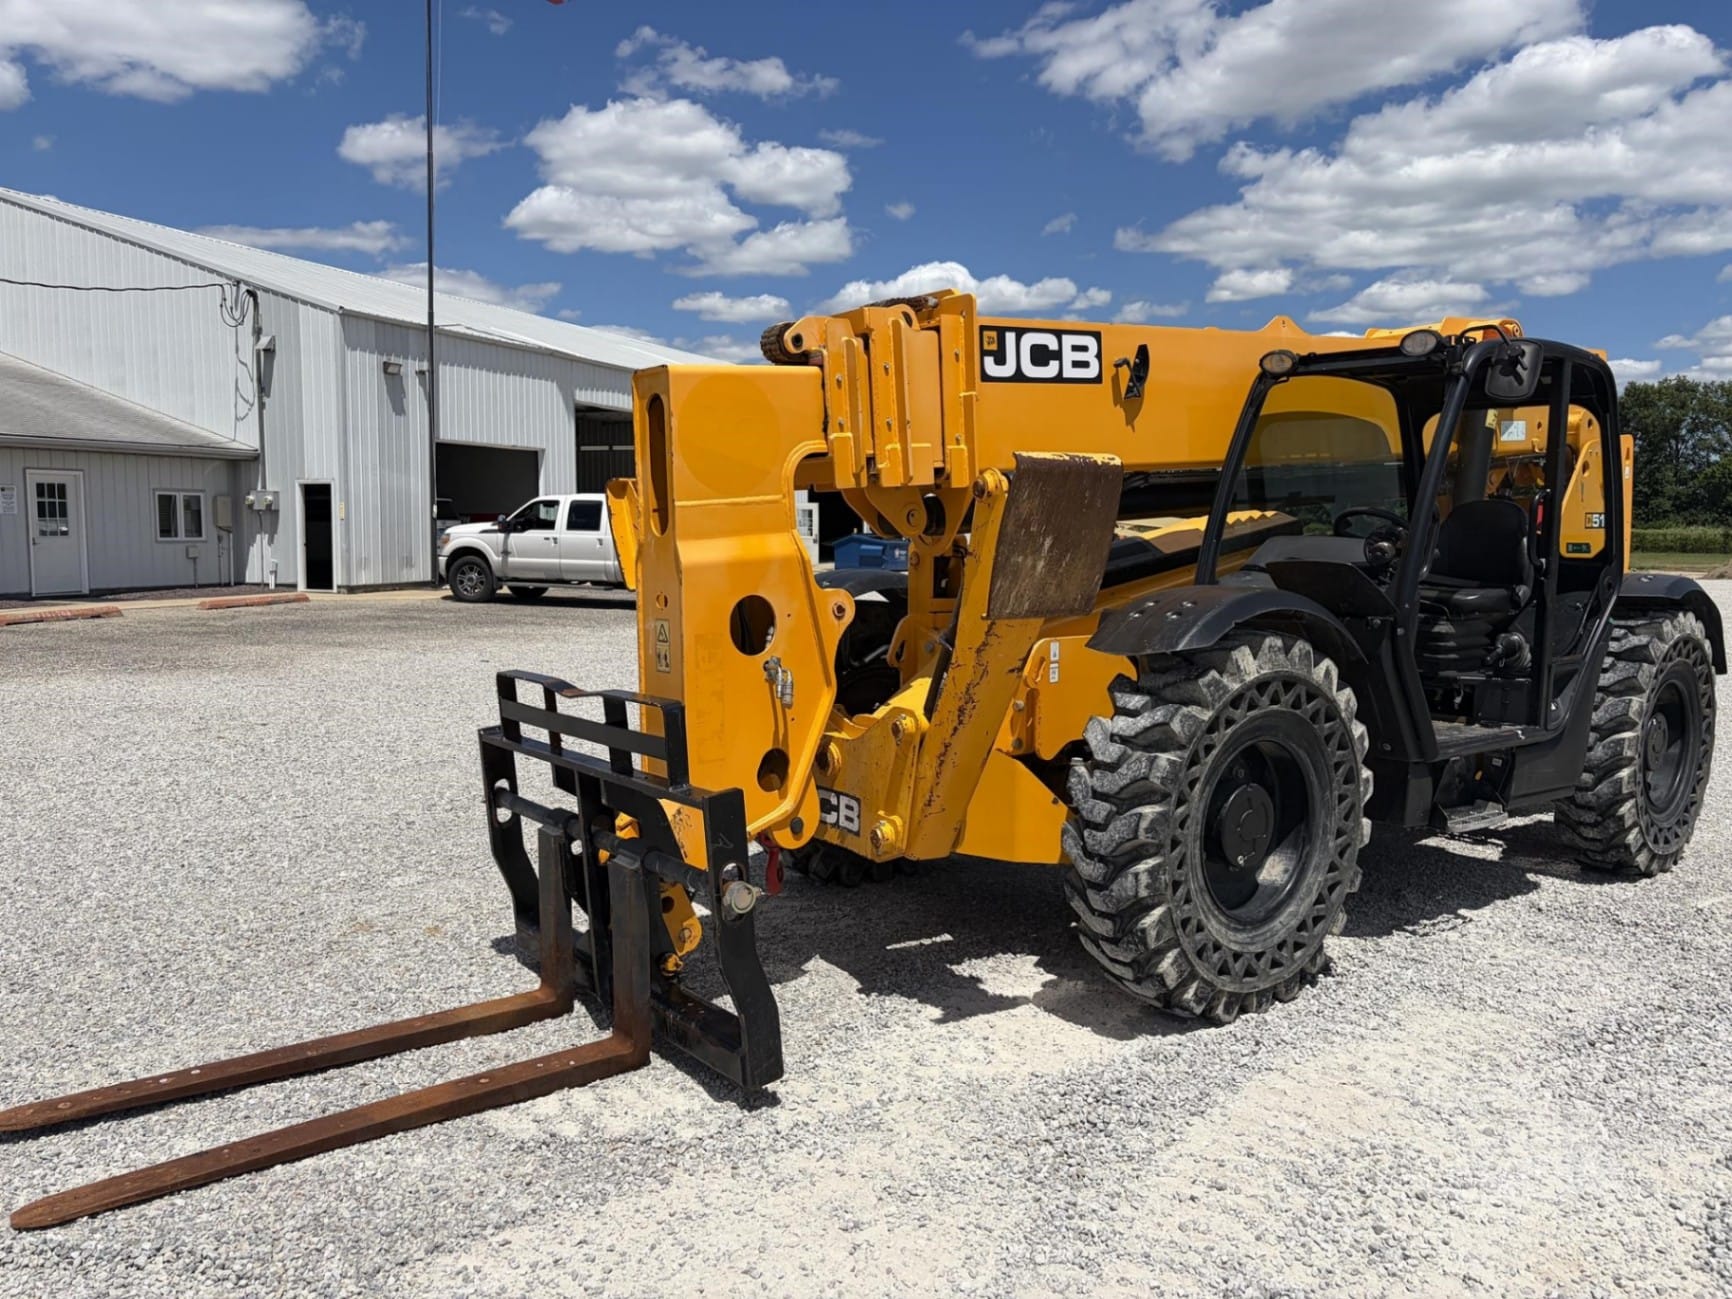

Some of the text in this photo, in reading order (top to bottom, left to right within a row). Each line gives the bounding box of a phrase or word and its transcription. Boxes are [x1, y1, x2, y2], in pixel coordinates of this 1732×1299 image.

[983, 331, 1100, 379] JCB
[1592, 513, 1605, 528] 51
[817, 788, 859, 832] CB
